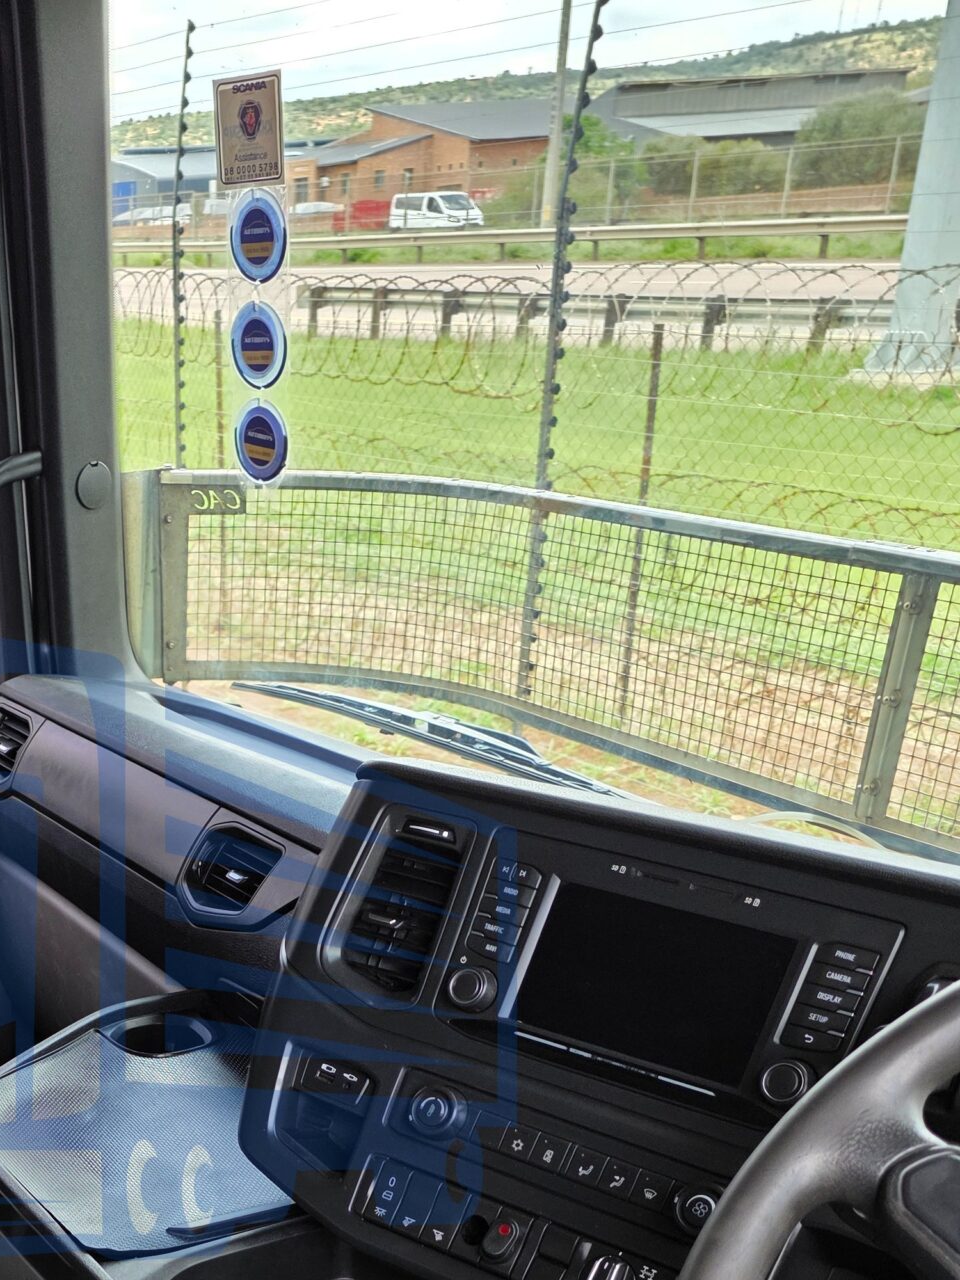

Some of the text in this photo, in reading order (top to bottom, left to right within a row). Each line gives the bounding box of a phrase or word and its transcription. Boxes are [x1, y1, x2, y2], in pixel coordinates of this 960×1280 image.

[232, 81, 267, 94] SCANIA
[503, 886, 519, 896] RADIO
[495, 905, 511, 915] MEDIA
[484, 922, 504, 935] TRAFFIC
[834, 949, 856, 961] PHONE
[826, 970, 852, 984] CAMERA
[816, 991, 842, 1004] DISPLAY
[808, 1012, 829, 1023] SETUP
